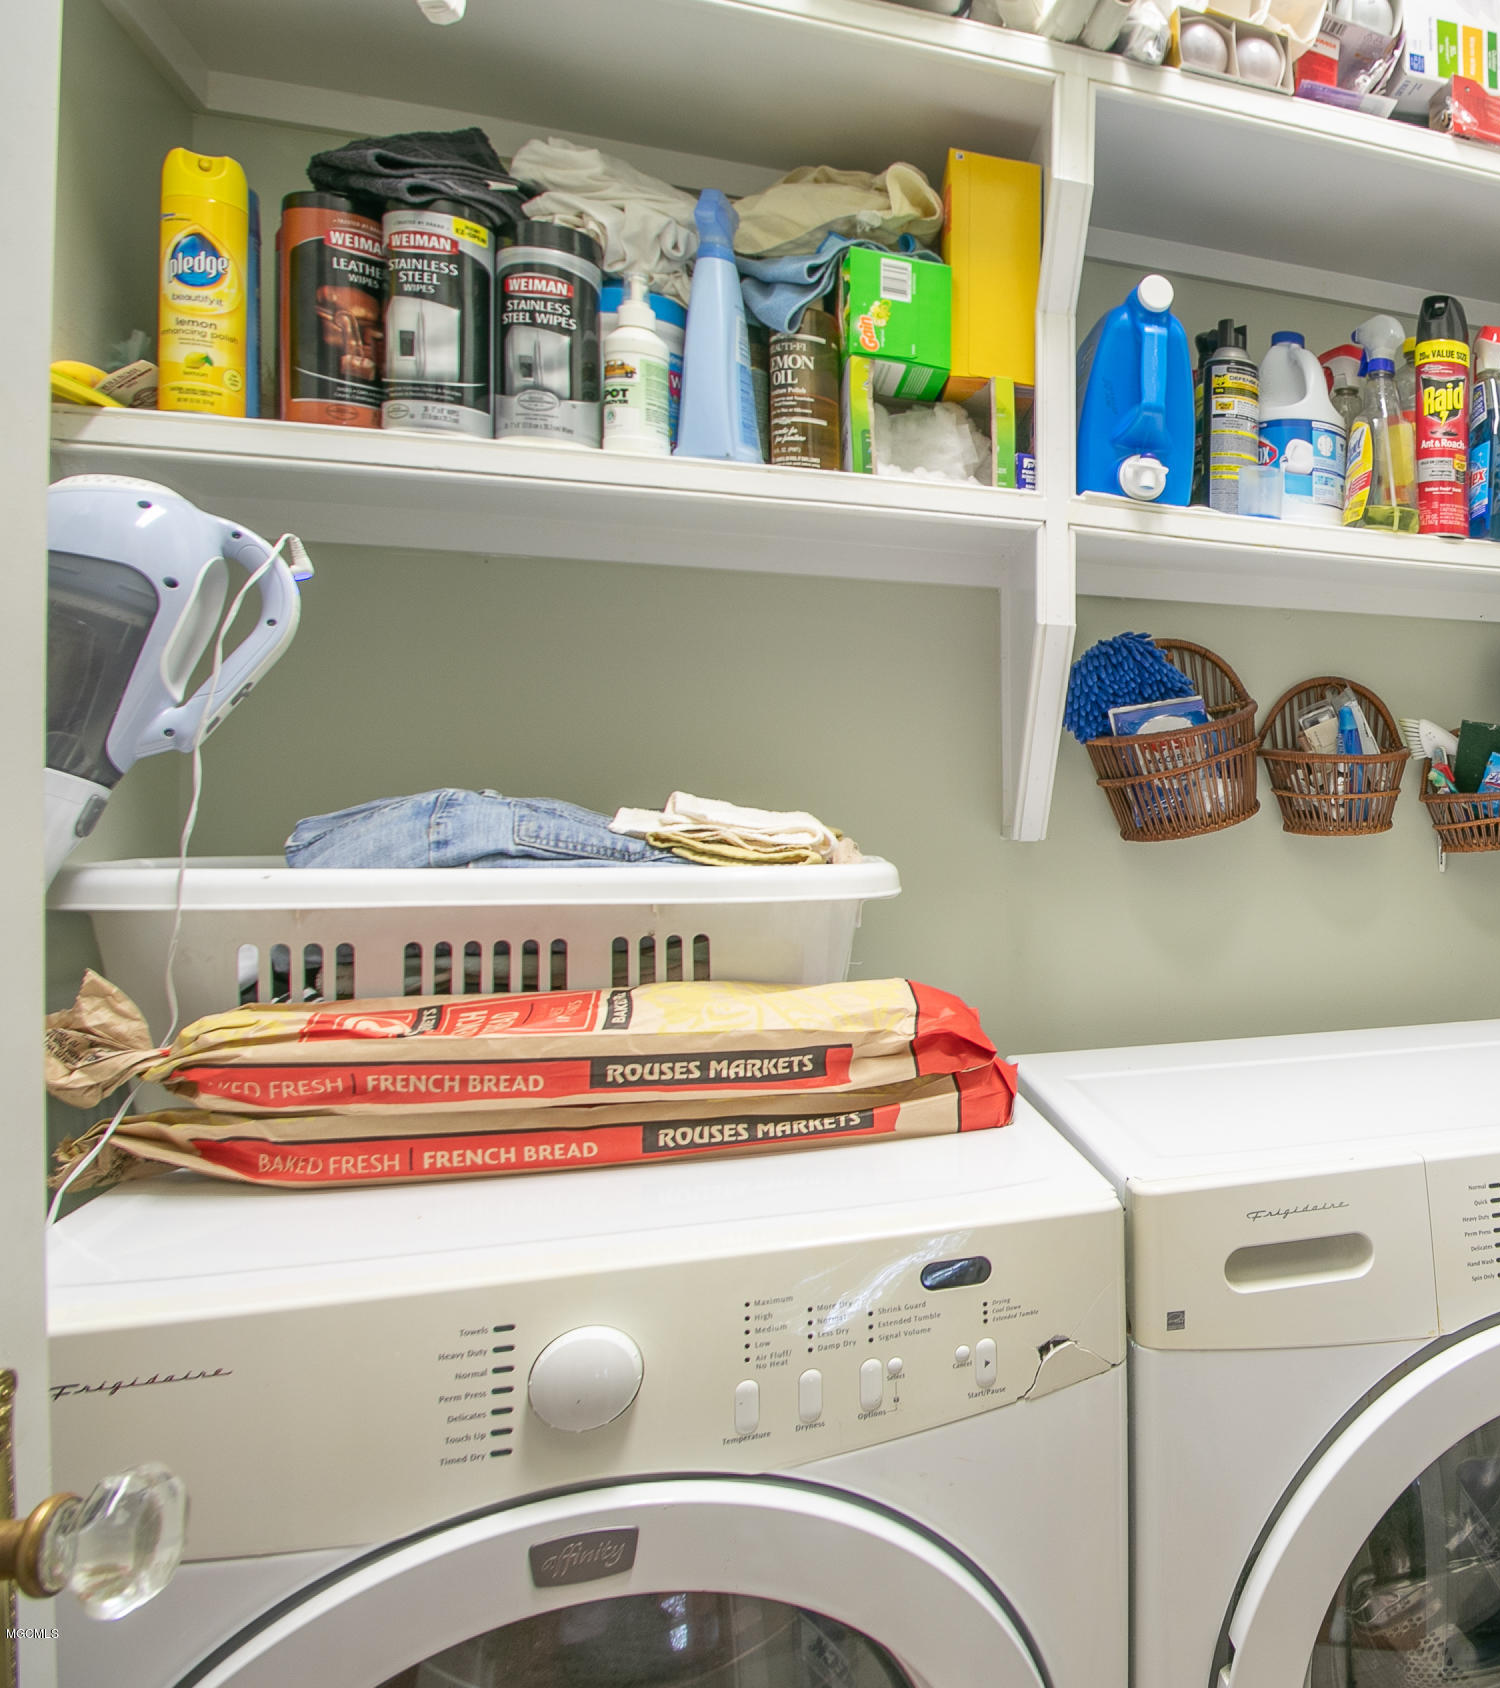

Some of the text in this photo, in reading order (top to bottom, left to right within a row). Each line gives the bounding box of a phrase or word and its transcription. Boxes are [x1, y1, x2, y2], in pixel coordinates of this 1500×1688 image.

[330, 230, 384, 256] WEIMA
[391, 232, 451, 251] WEIMAN
[168, 250, 228, 283] pledge
[332, 256, 384, 280] LEATHE
[388, 258, 459, 276] STAINLESS
[348, 273, 380, 289] WIPES
[399, 271, 441, 285] STEEL
[403, 283, 436, 294] WIPES
[508, 278, 568, 296] WEIMAN
[507, 299, 571, 316] STAINLESS
[175, 317, 217, 330] lemon
[502, 312, 577, 330] STEEL WIPES
[858, 314, 880, 352] Gain
[1431, 349, 1455, 359] VALUE
[770, 354, 815, 371] EMON
[773, 369, 798, 386] OIL
[1423, 381, 1465, 417] Raid
[1421, 439, 1435, 449] Ant
[1440, 438, 1465, 450] Roach
[269, 1054, 813, 1099] FRESH FRENCH BREAD ROUSES MARKETS
[258, 1111, 861, 1175] BAKED FRESH FRENCH BREAD ROUSES MARKETS
[1468, 1183, 1487, 1191] Normal
[1473, 1199, 1488, 1207] Quick
[1246, 1201, 1350, 1223] Frigidaire
[1464, 1230, 1478, 1238] Perm
[1470, 1244, 1493, 1252] Delicates
[1467, 1258, 1495, 1268] Hand Wash
[1483, 1273, 1495, 1281] Only
[753, 1295, 794, 1306] Maximum
[991, 1298, 1012, 1306] Drying
[816, 1303, 836, 1312] More
[878, 1301, 927, 1315] Shrink Guard
[754, 1312, 774, 1321] High
[878, 1311, 942, 1329] Extended Tumble
[992, 1309, 1039, 1322] Extended Tumble
[459, 1326, 489, 1337] Towels
[754, 1323, 788, 1334] Medium
[817, 1327, 850, 1338] Less Dry
[878, 1327, 932, 1342] Signal Volume
[754, 1341, 771, 1349] Low
[817, 1339, 857, 1352] Damp Dry
[437, 1349, 488, 1362] Heavy Duty
[755, 1349, 793, 1362] Air Fluff/
[769, 1359, 789, 1368] Heat
[952, 1360, 973, 1369] Cancel
[454, 1368, 488, 1381] Normal
[886, 1373, 905, 1382] Select
[48, 1367, 233, 1402] Frigidaire
[438, 1390, 487, 1405] Perm Press
[967, 1386, 1006, 1400] Start/Pause
[446, 1411, 487, 1424] Delicates
[857, 1410, 887, 1421] Options
[795, 1420, 826, 1433] Dryness
[445, 1431, 487, 1445] Touch Up
[722, 1430, 772, 1446] Temperature
[440, 1453, 486, 1467] Timed Dry
[541, 1540, 626, 1578] affinity
